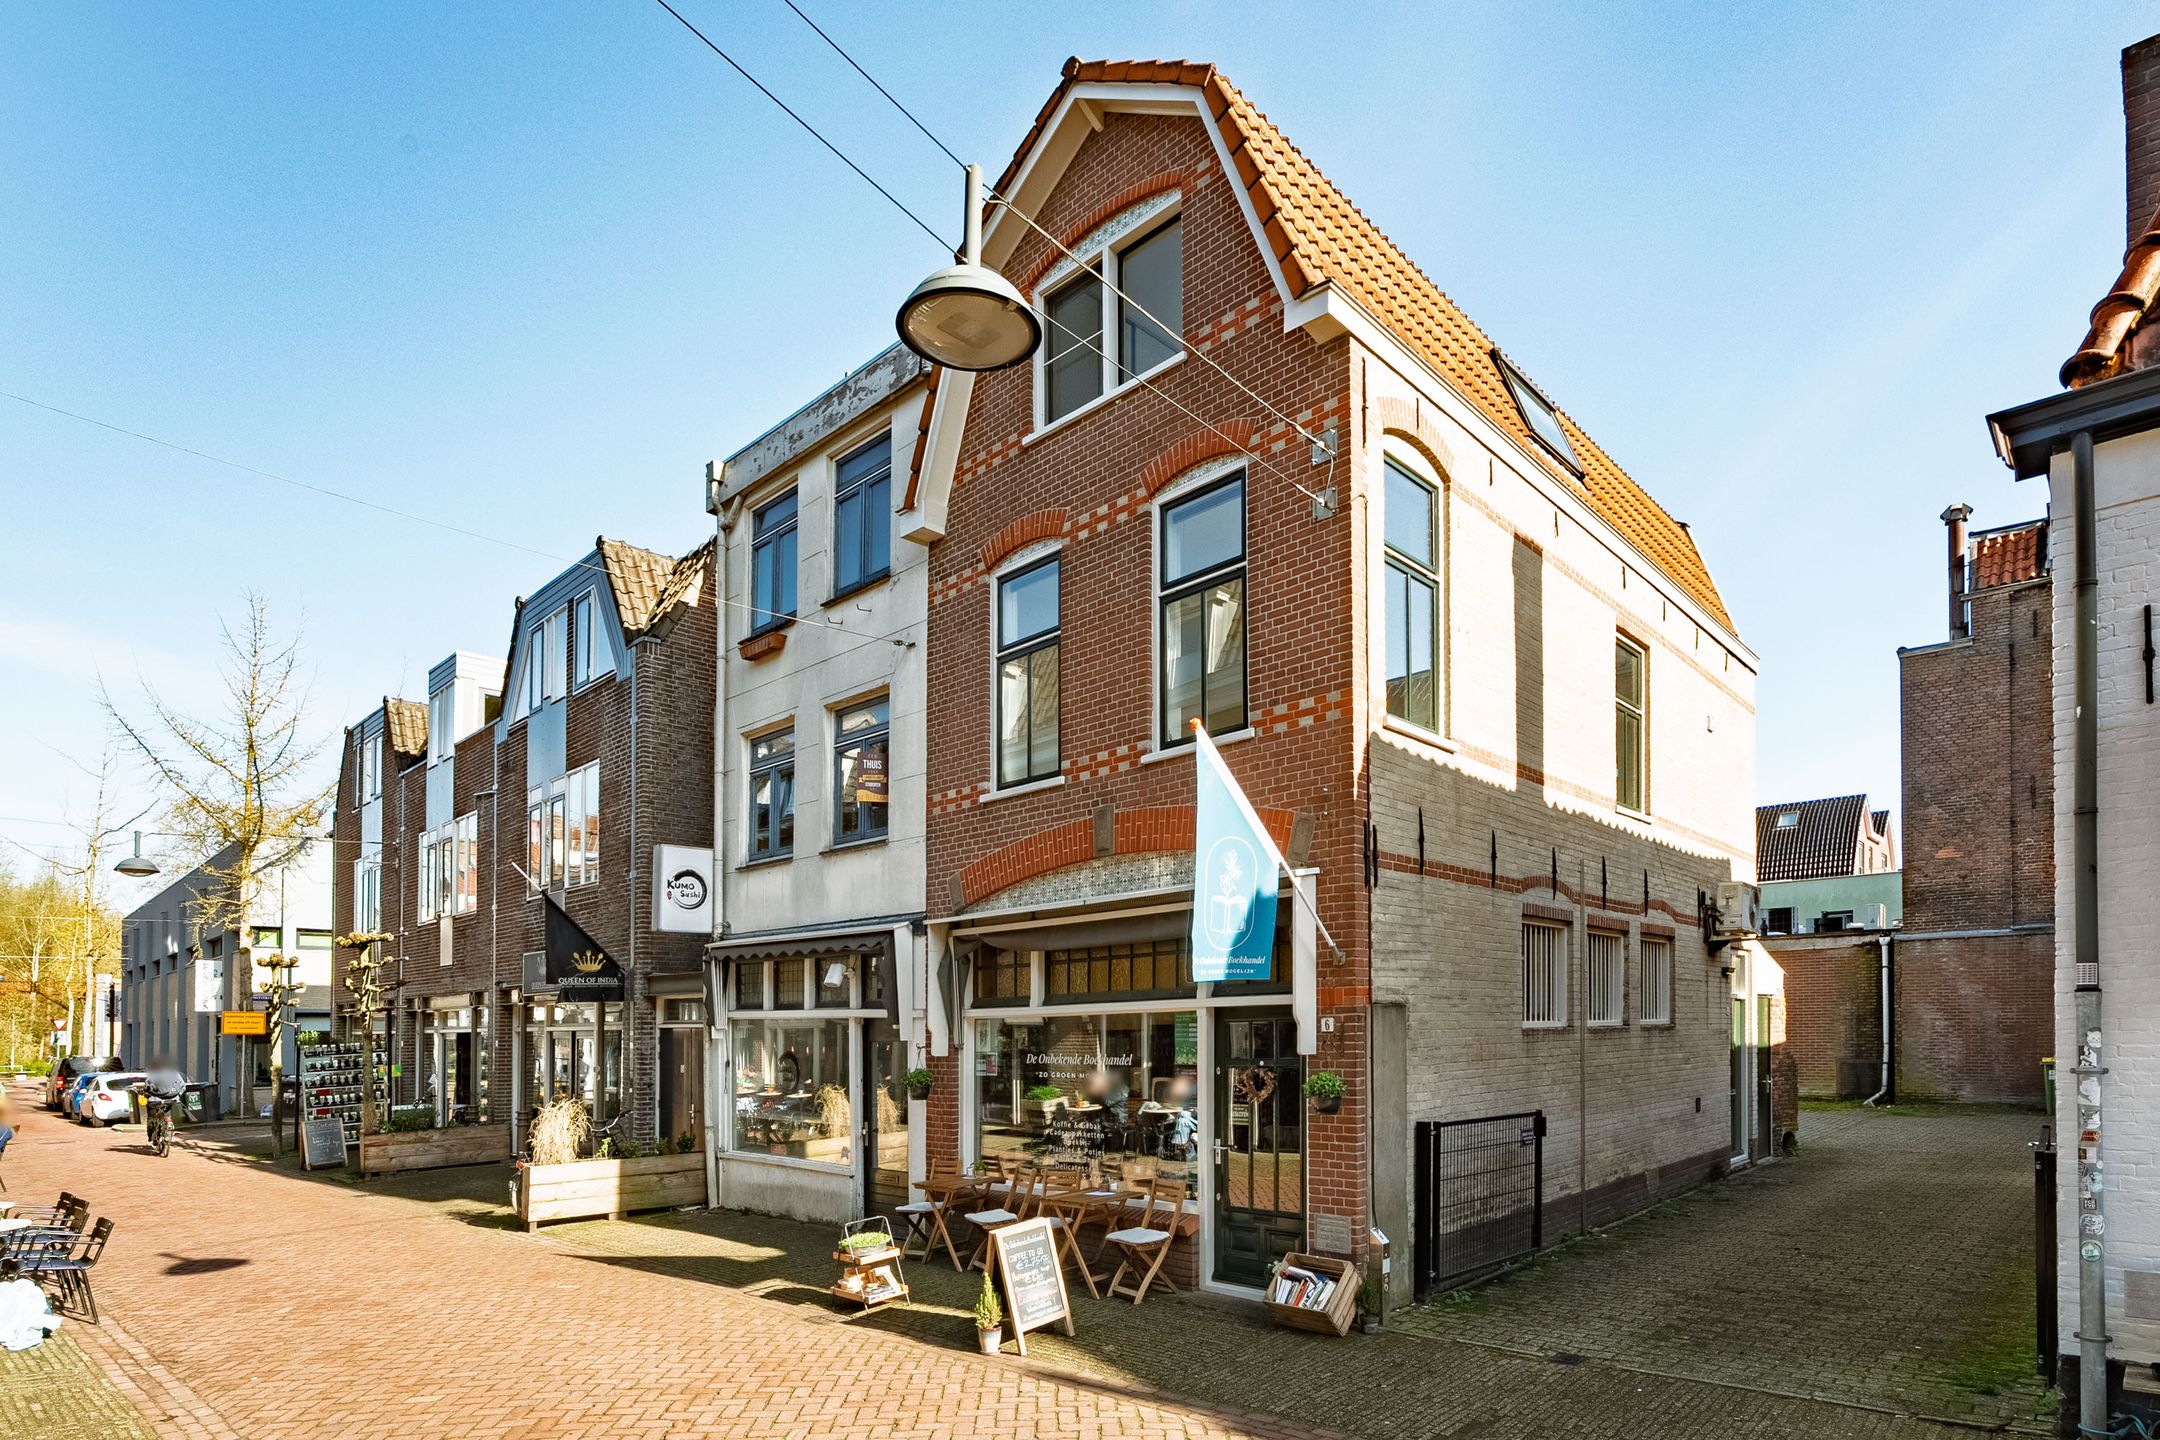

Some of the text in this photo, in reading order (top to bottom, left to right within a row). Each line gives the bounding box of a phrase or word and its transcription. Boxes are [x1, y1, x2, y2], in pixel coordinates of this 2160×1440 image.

[863, 759, 882, 769] THUIS
[680, 890, 701, 898] Sushi
[1227, 956, 1266, 964] Boekhandel
[1324, 1019, 1330, 1031] 6
[1026, 1053, 1037, 1064] De
[1038, 1053, 1082, 1065] Onbekende
[1050, 1071, 1076, 1079] GROEN
[1052, 1120, 1101, 1130] Koffie & Gebak
[1049, 1145, 1075, 1155] Plantjes
[1084, 1147, 1105, 1157] Potjes
[1055, 1162, 1093, 1172] Delicatess
[1009, 1252, 1028, 1263] COFFEE
[1028, 1249, 1035, 1258] TO
